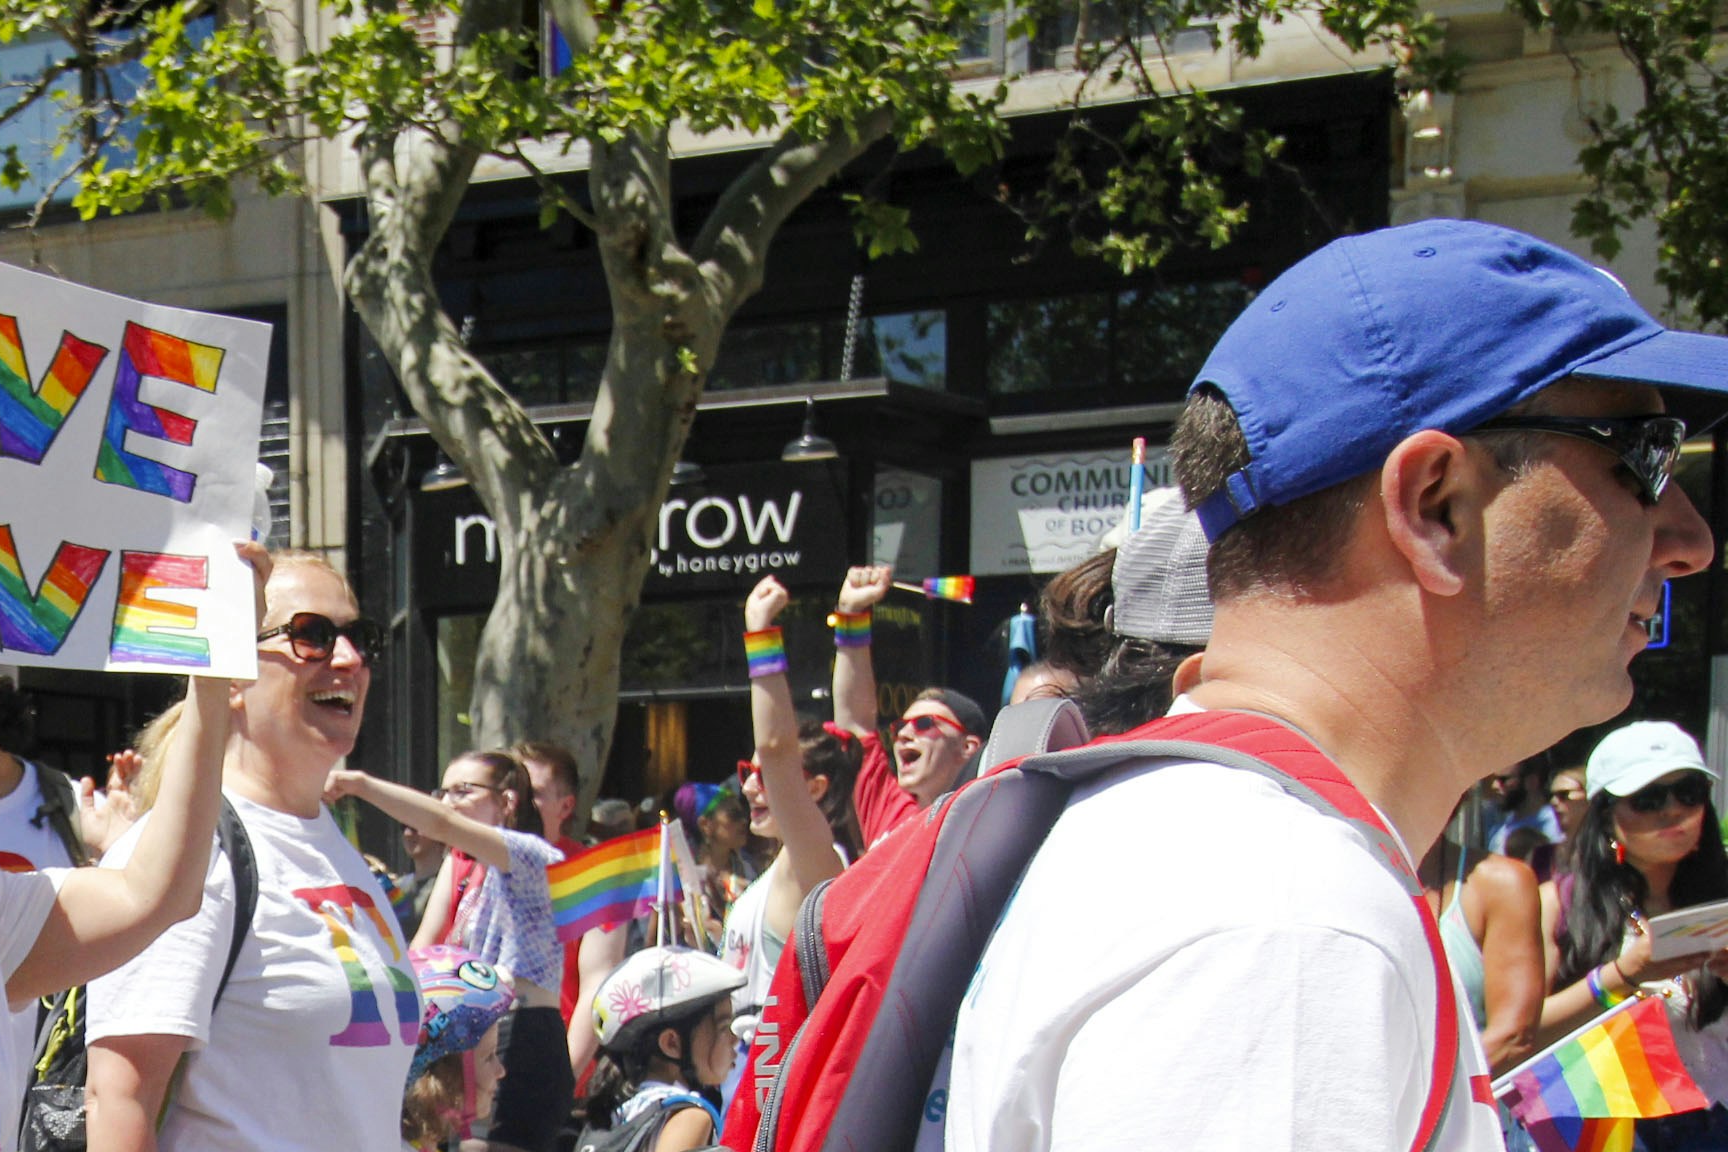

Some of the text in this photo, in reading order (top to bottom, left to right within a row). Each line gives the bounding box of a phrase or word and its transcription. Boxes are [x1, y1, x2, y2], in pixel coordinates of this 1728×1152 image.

[1010, 464, 1169, 497] COMMUNI
[1058, 492, 1127, 513] CHUR
[1071, 516, 1119, 536] BOS
[658, 550, 800, 578] by honeygrow
